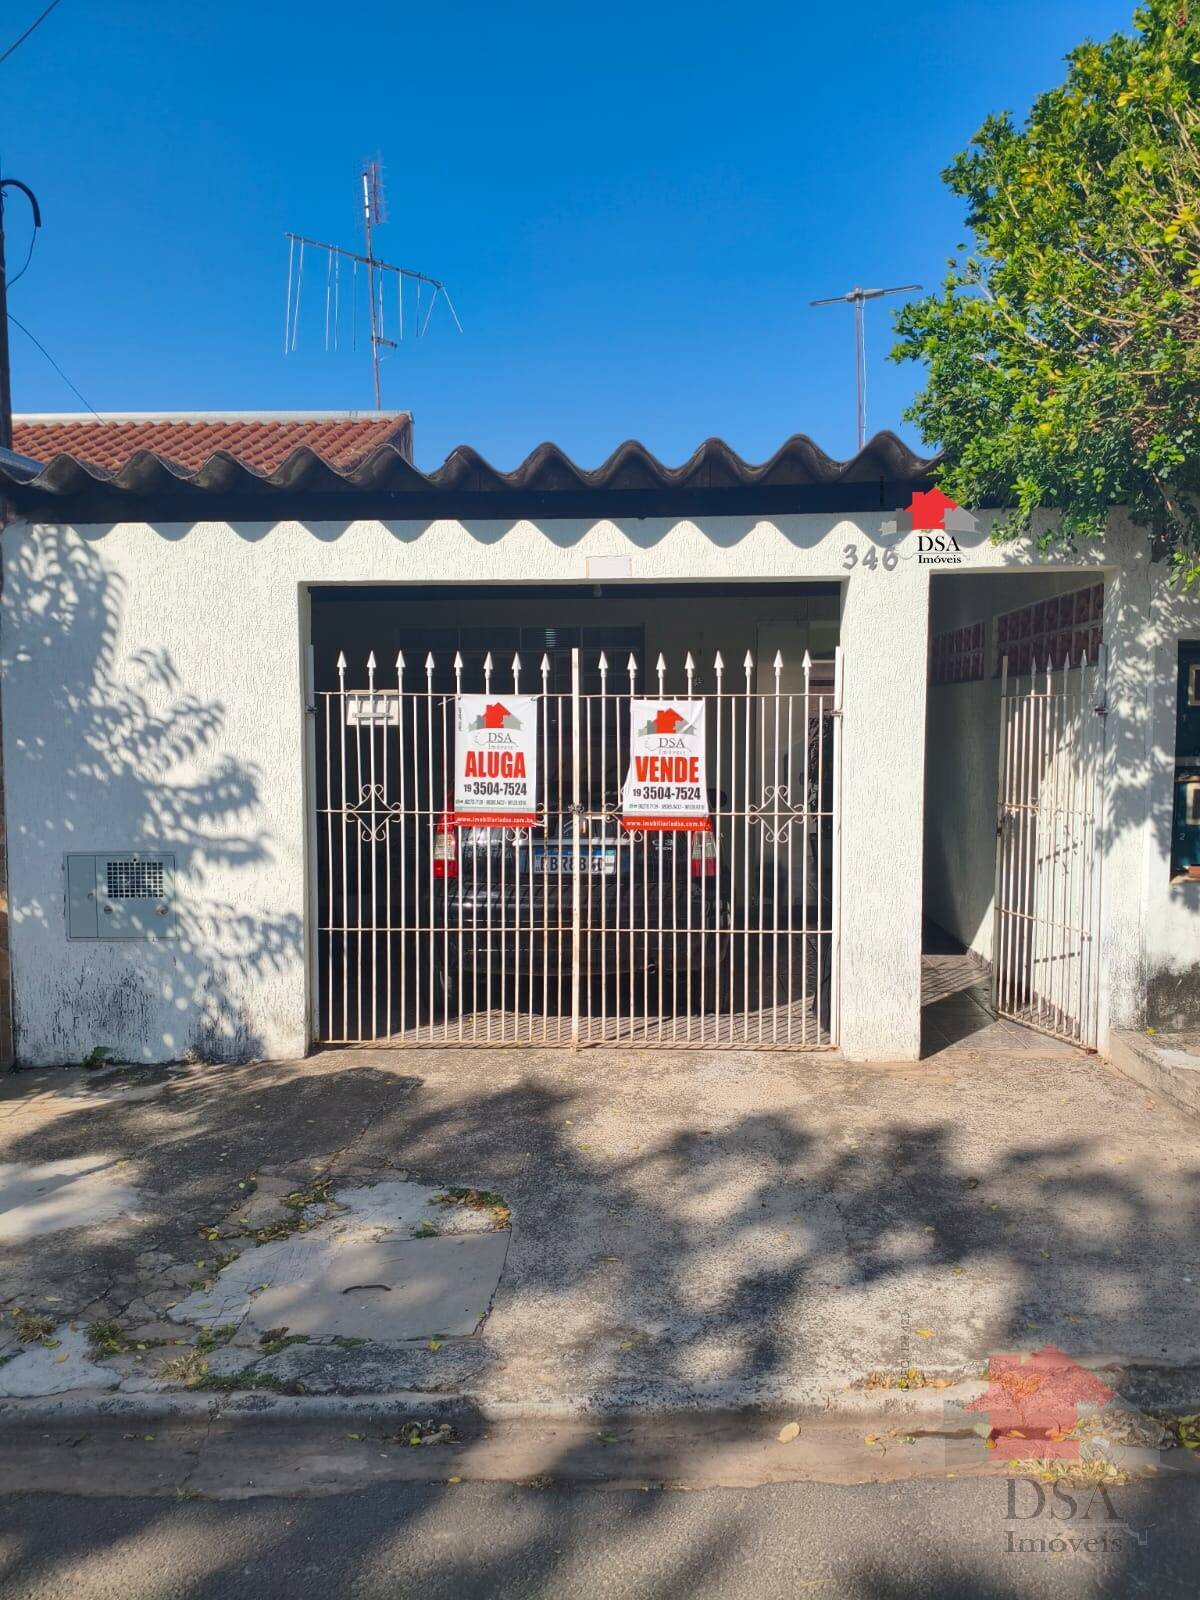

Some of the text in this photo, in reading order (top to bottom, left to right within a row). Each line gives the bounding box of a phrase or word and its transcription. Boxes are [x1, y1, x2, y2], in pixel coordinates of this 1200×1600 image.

[842, 544, 899, 571] 346
[488, 732, 513, 743] DSA
[658, 737, 685, 748] DSA
[465, 751, 526, 778] ALUGA
[635, 756, 699, 783] VENDE
[464, 781, 527, 796] 19 3504-7524
[633, 786, 701, 800] 19 3504-7524
